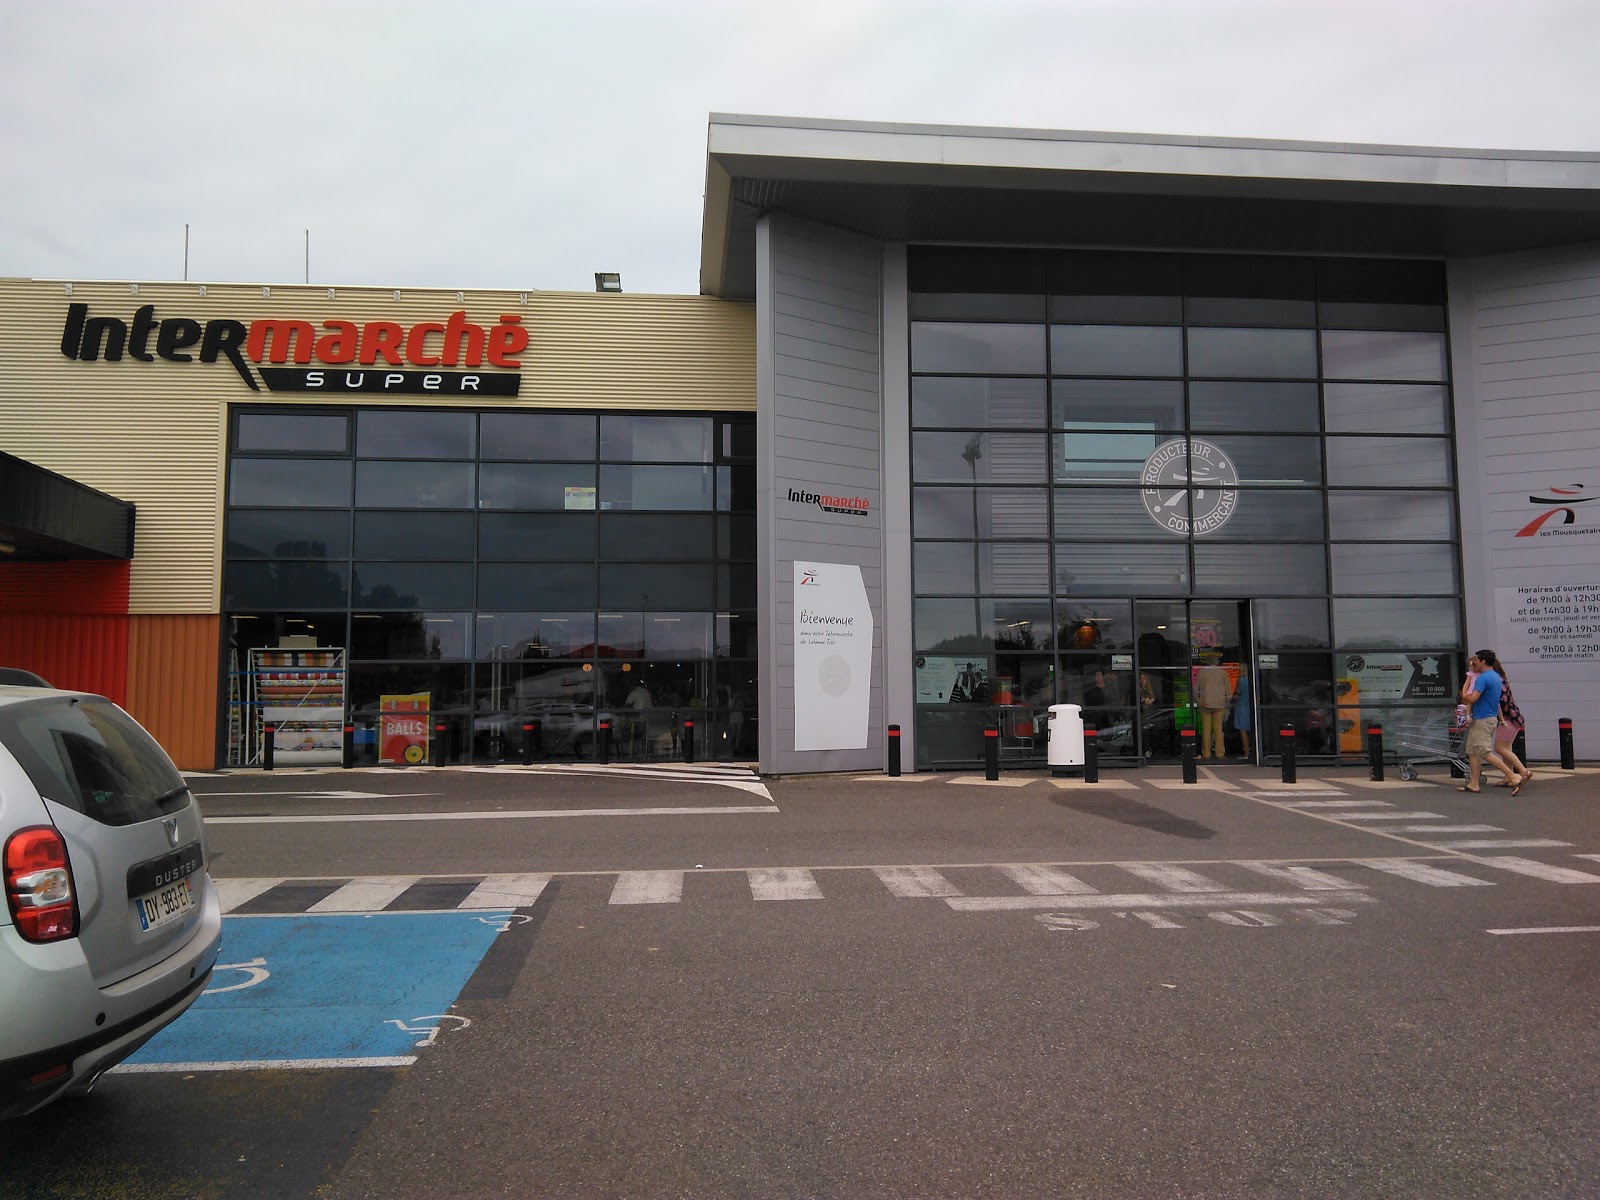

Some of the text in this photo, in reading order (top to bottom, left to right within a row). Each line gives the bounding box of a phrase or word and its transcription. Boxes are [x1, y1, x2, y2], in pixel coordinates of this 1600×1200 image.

[60, 302, 529, 391] Intermarché
[305, 371, 481, 391] SUPER
[1146, 443, 1212, 495] PRODUCTEUR
[787, 488, 869, 511] Intermarché
[1540, 595, 1563, 603] 9h00
[1574, 594, 1600, 602] 12h30
[800, 609, 854, 626] Bienvenue
[1529, 607, 1540, 615] de
[1543, 606, 1571, 614] 14h30
[1573, 605, 1579, 613] à
[1582, 605, 1600, 613] 19h
[1541, 626, 1564, 634] 9h00
[1566, 625, 1572, 633] à
[1542, 645, 1565, 653] 9h00
[1567, 644, 1573, 652] à
[1576, 644, 1600, 652] 12h0
[386, 721, 423, 736] BALLS
[155, 859, 197, 887] DUSTER
